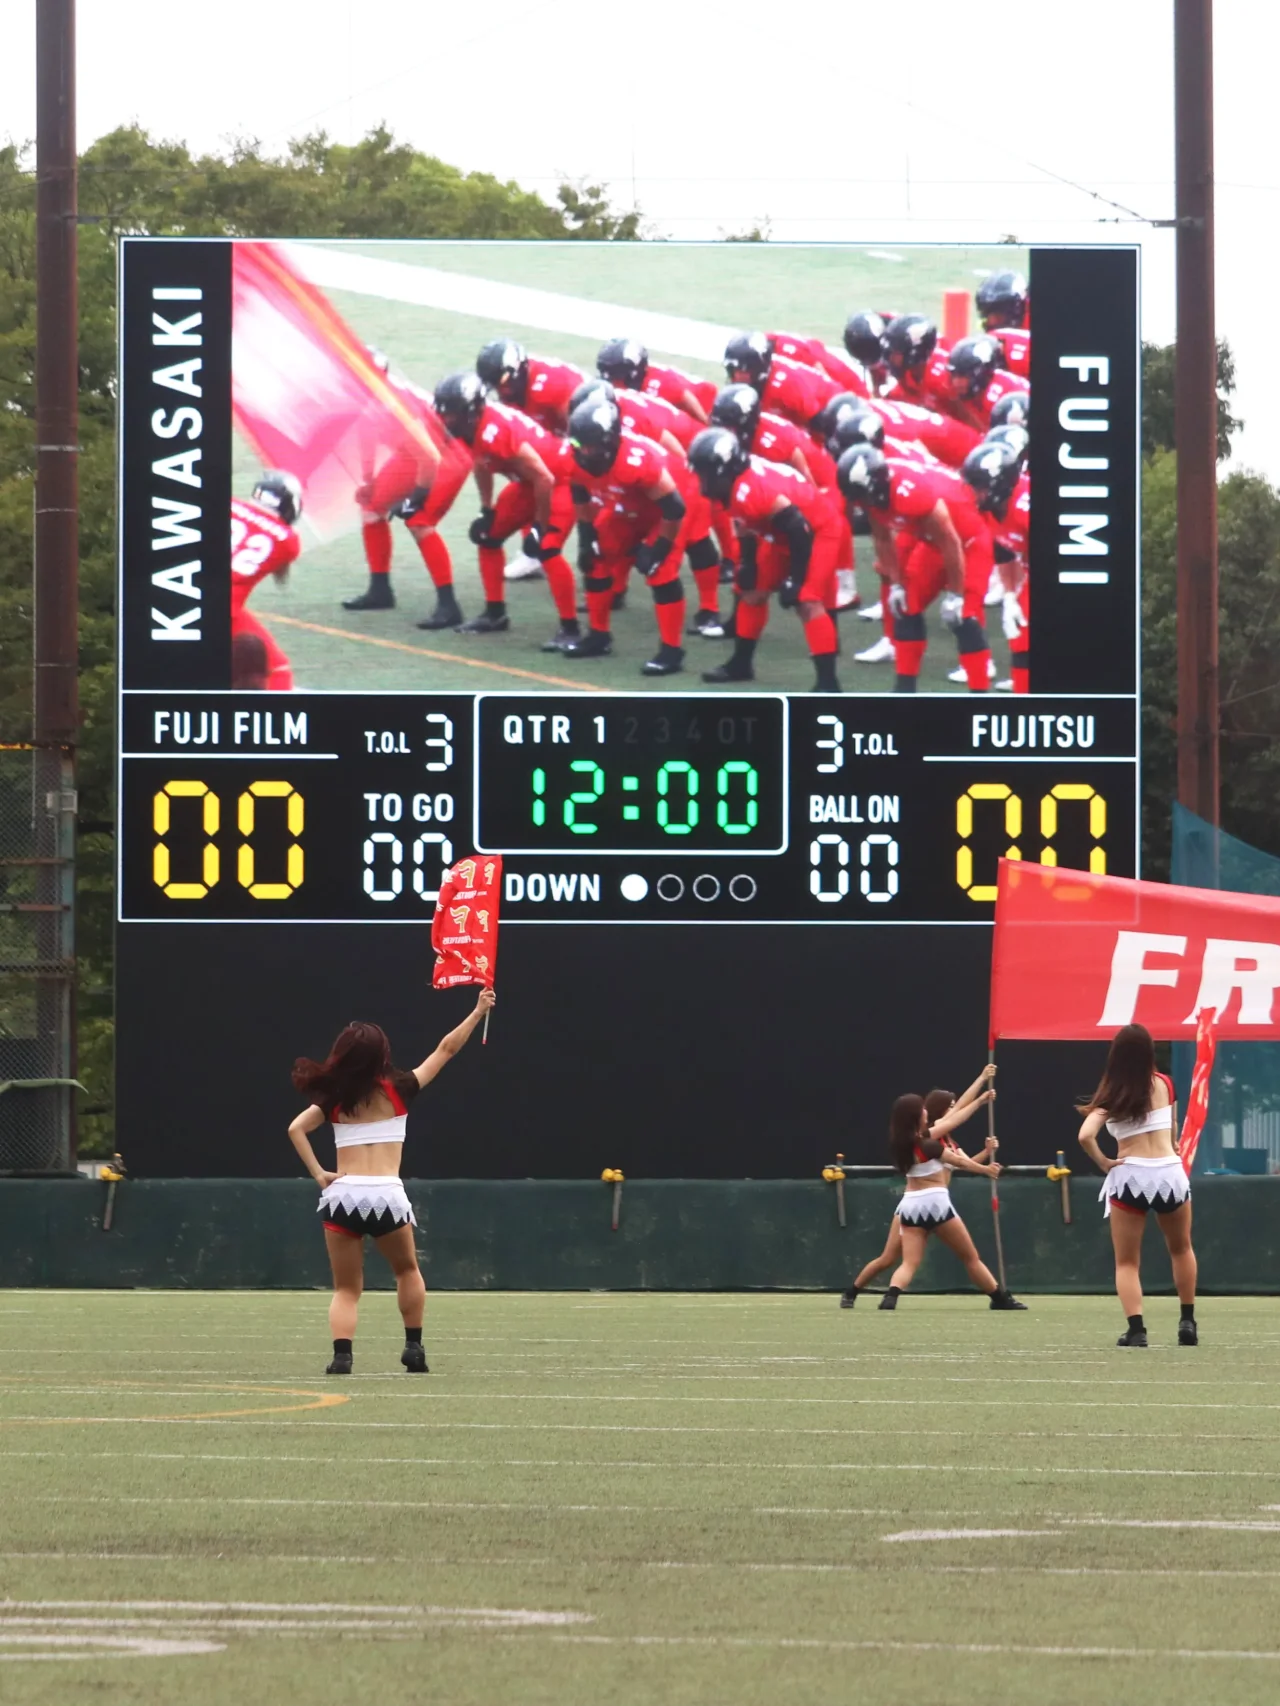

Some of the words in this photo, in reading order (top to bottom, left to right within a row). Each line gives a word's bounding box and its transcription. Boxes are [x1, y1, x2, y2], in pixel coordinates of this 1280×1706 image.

[151, 287, 203, 641] KAWASAKI
[1058, 356, 1109, 584] FUJIMI
[153, 711, 219, 745] FUJI
[234, 711, 308, 745] FILM
[364, 730, 411, 754] T.O.L
[425, 713, 453, 772] 3
[503, 715, 570, 744] QTR
[593, 715, 606, 744] 1
[816, 714, 844, 773] 3
[852, 733, 899, 756] T.O.L
[972, 714, 1095, 748] FUJITSU
[363, 793, 402, 822] TO
[412, 793, 454, 822] GO
[532, 760, 758, 835] 12:00
[810, 795, 863, 823] BALL
[868, 795, 899, 823] ON
[153, 780, 304, 900] 00
[363, 832, 453, 901] 00
[810, 834, 899, 902] 00
[506, 873, 600, 902] DOWN
